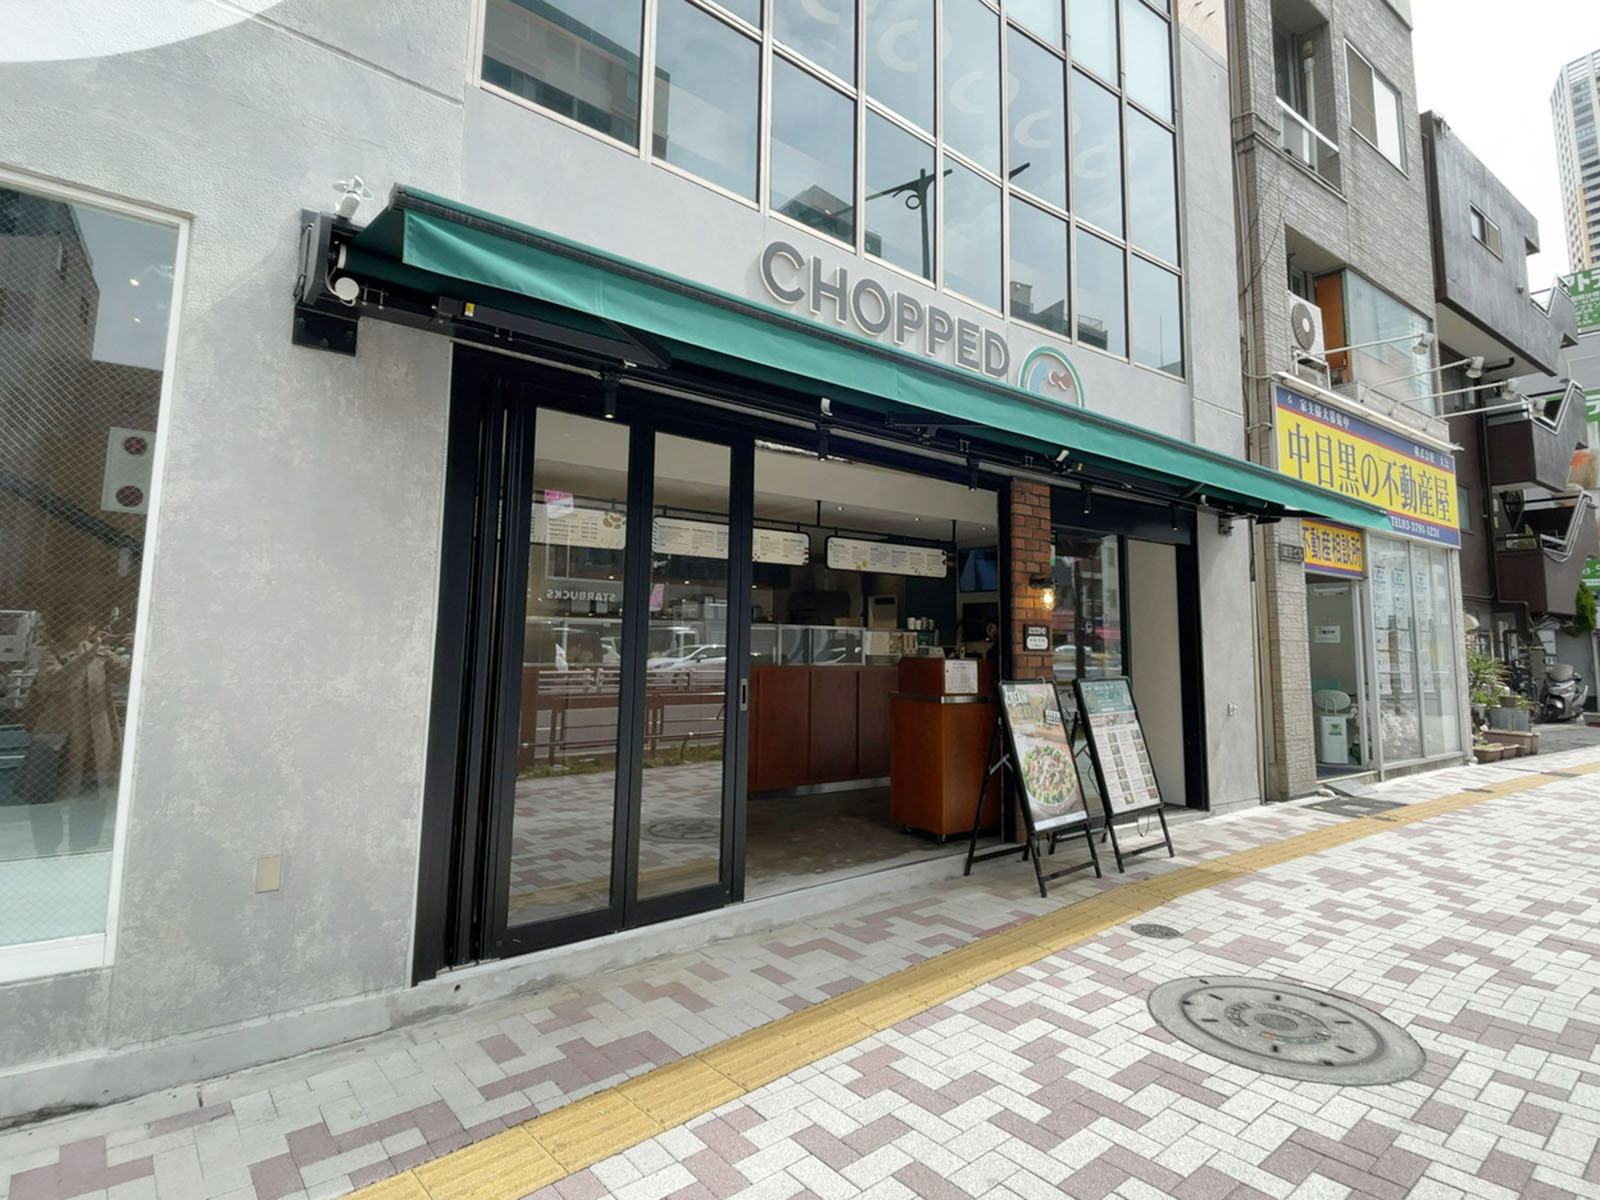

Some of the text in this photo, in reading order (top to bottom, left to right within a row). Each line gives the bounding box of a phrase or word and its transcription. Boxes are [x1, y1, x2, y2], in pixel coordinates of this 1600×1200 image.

[759, 241, 1011, 379] CHOPPED
[1287, 422, 1452, 522] 中目黒の不動産屋
